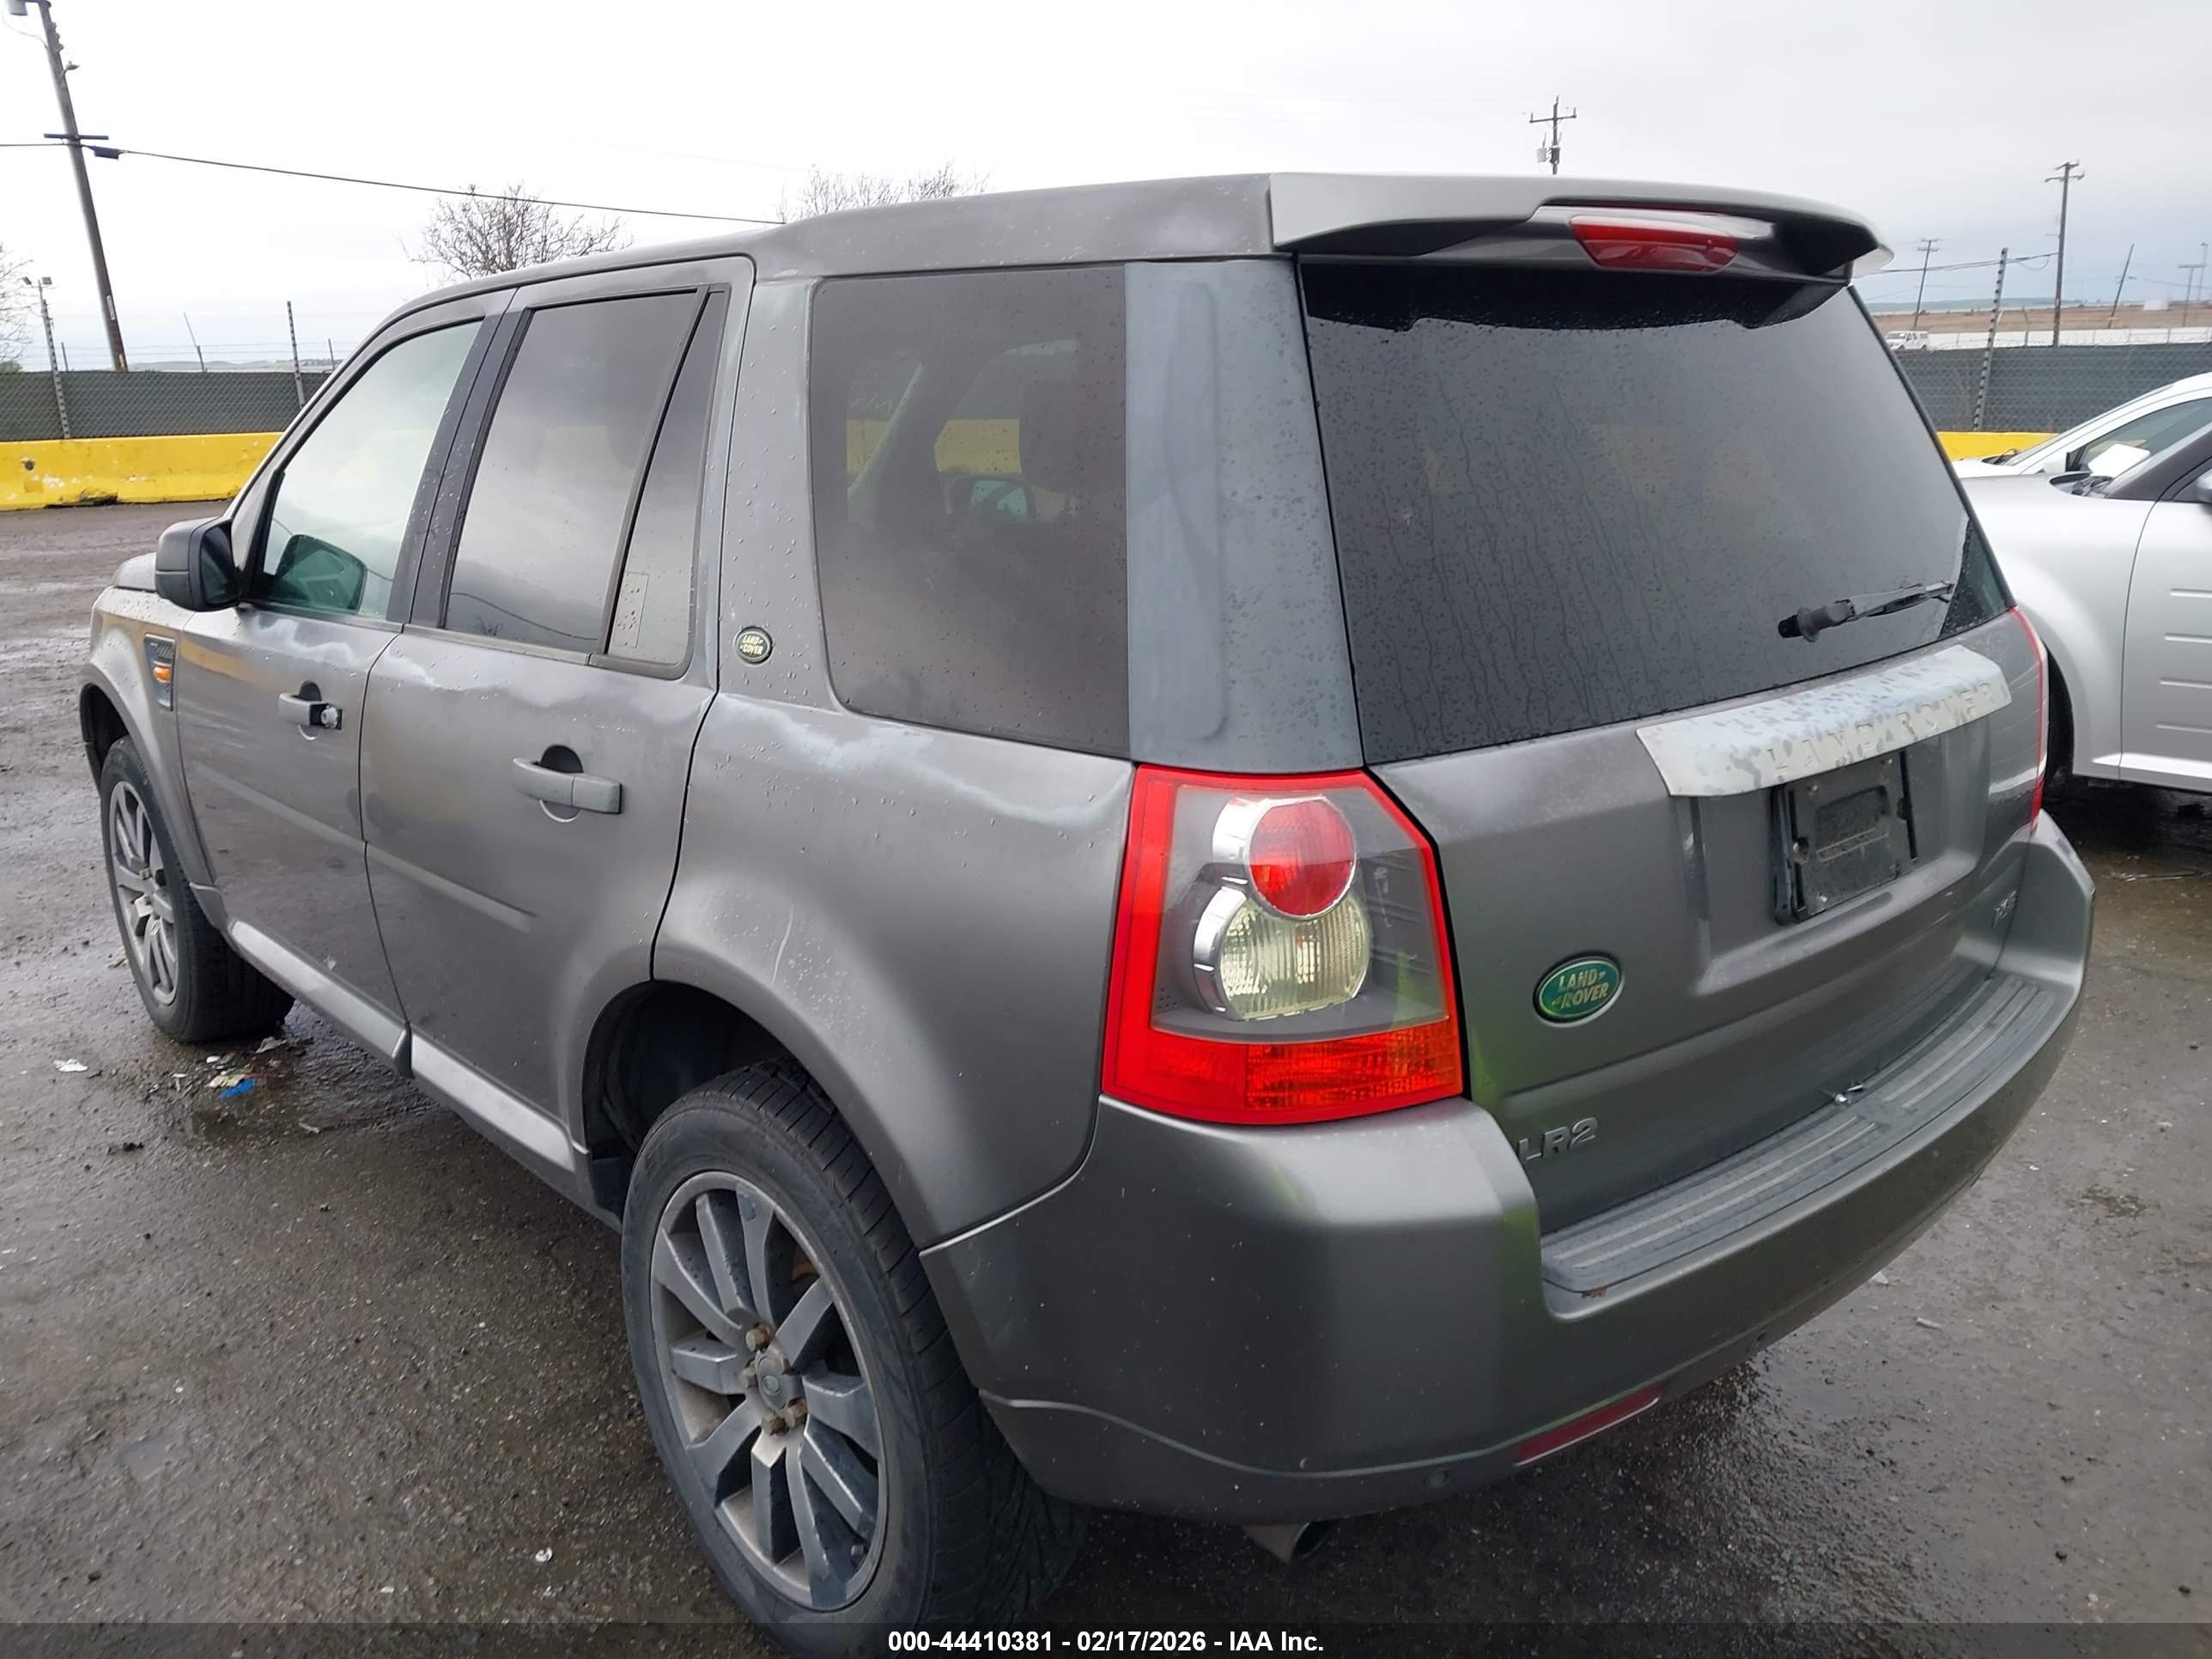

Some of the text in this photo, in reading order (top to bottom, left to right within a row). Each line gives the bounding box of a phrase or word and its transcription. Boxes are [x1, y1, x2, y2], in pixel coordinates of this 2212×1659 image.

[1766, 720, 1879, 778] LAND
[1558, 969, 1598, 992] LAND
[1560, 981, 1609, 1009] ROVER
[1517, 1116, 1598, 1160] LR2
